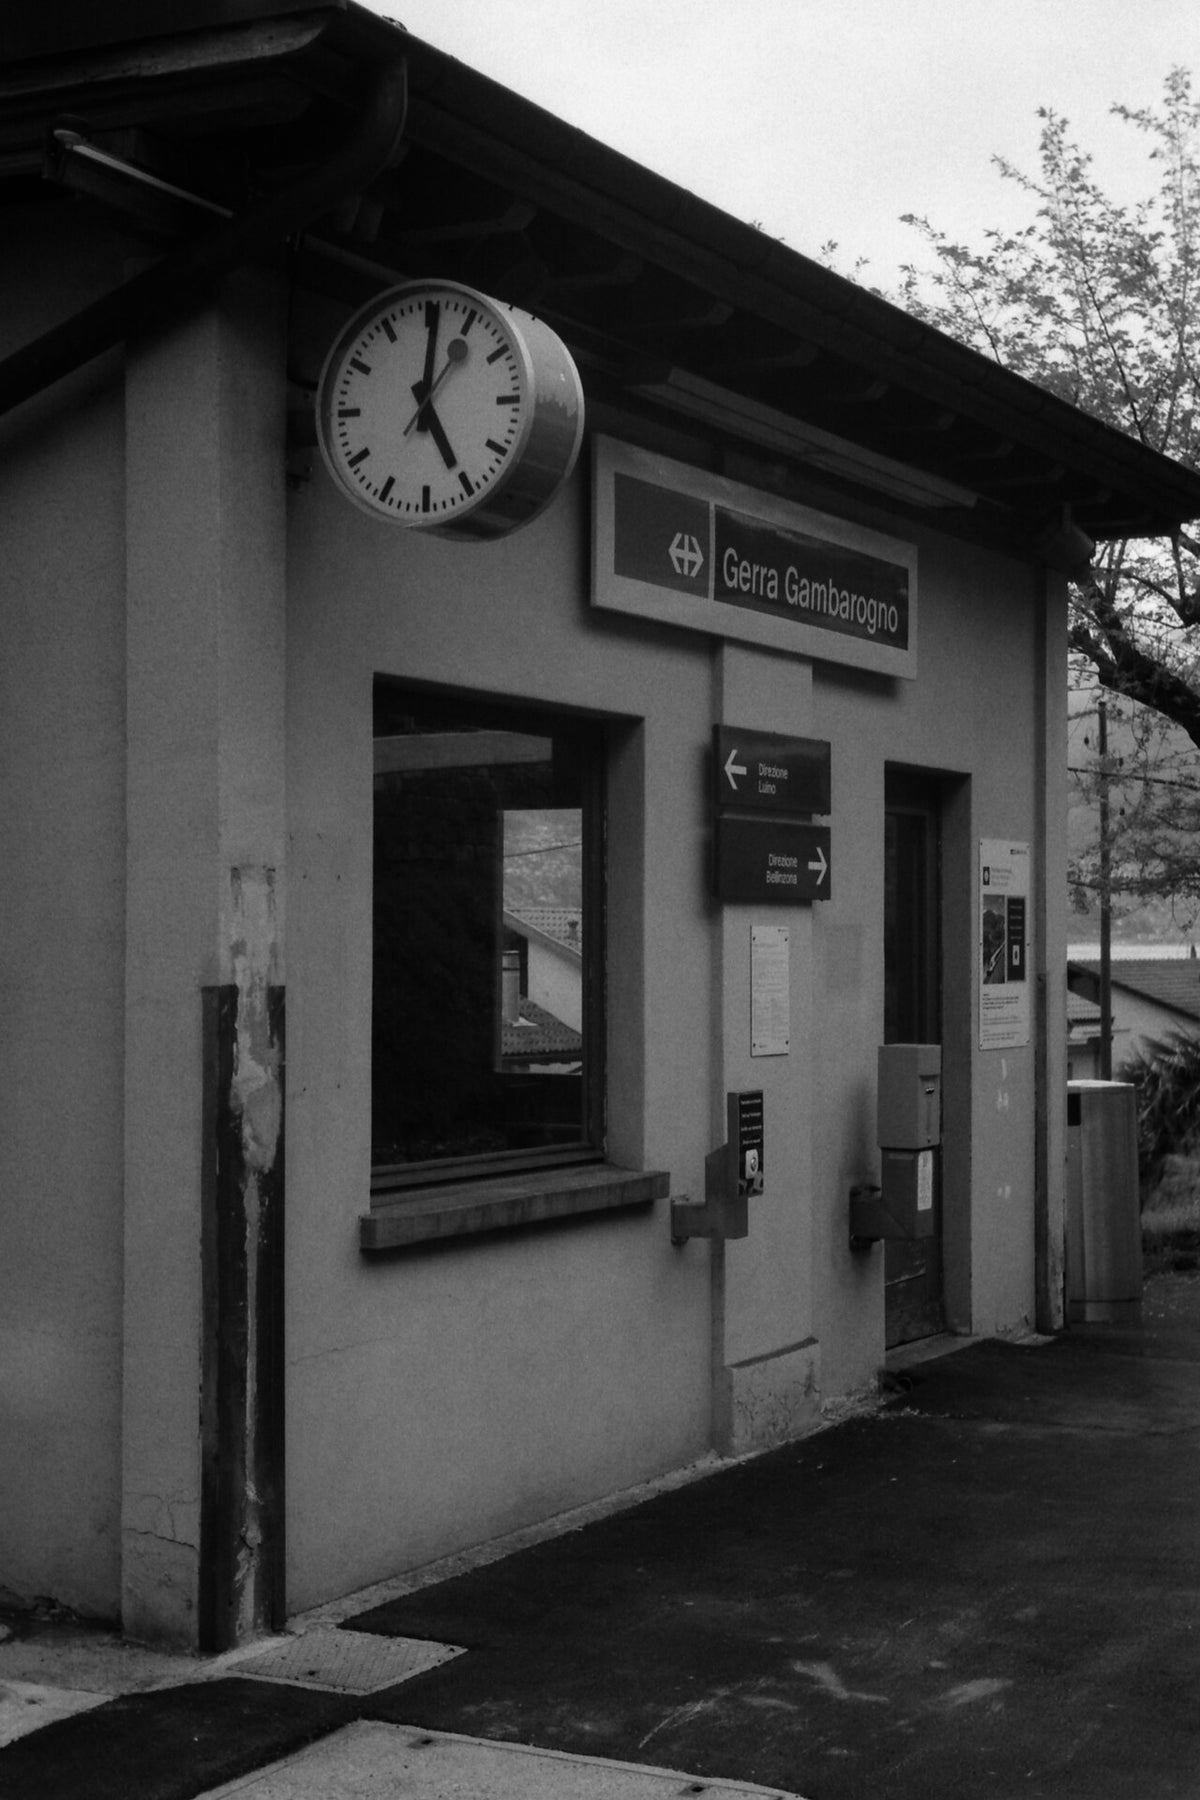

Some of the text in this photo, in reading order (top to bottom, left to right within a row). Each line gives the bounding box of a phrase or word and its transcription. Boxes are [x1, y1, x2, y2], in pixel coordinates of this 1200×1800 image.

[723, 547, 898, 634] Gerra Gambarogno
[758, 763, 788, 779] Direzione
[758, 781, 776, 794] Luino
[768, 854, 798, 868] Direzione
[766, 870, 798, 885] Bellinzona
